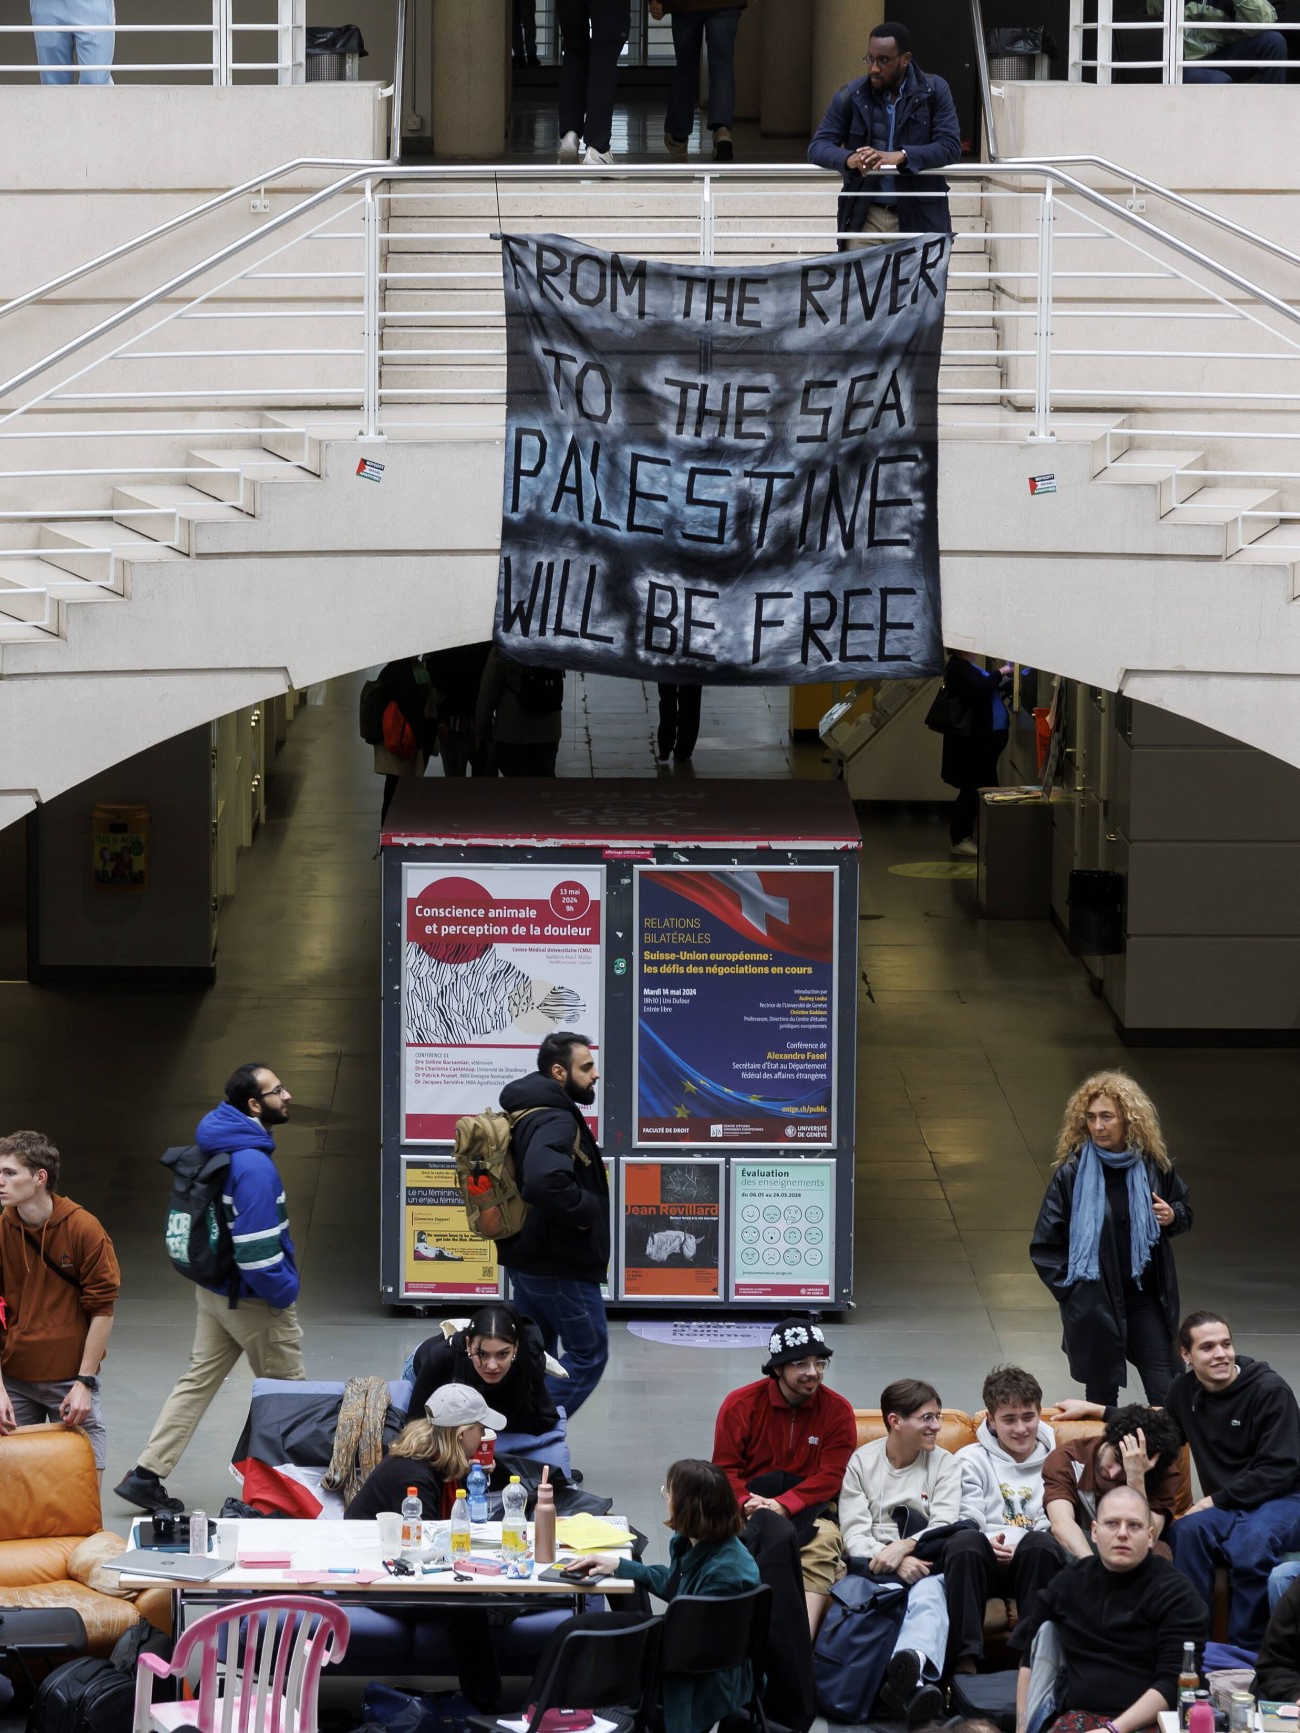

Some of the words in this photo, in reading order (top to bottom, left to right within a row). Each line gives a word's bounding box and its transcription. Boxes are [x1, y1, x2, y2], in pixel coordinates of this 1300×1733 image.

[508, 235, 648, 322] FROM
[676, 275, 770, 330] THE
[798, 235, 948, 330] RIVER
[540, 347, 613, 425] TO
[664, 377, 770, 441] THE
[794, 370, 907, 445] SEA
[512, 426, 918, 550] PALESTINE
[503, 555, 614, 645] WILL
[644, 580, 720, 663] BE
[753, 587, 918, 665] FREE
[415, 906, 484, 918] Conscience
[488, 907, 537, 918] animale
[644, 918, 700, 928] RELATIONS
[425, 924, 438, 935] et
[441, 923, 508, 937] perception
[511, 924, 526, 936] de
[530, 924, 540, 936] la
[544, 925, 591, 936] douleur
[644, 931, 711, 944] BILATÉRALES
[644, 951, 708, 961] Suisse-Union
[644, 964, 658, 974] les
[660, 964, 684, 974] défis
[686, 964, 703, 974] des
[705, 964, 769, 976] négociations
[771, 966, 783, 974] en
[785, 966, 813, 974] cours
[766, 1052, 805, 1060] Alexandre
[806, 1052, 827, 1060] Fasel
[761, 1061, 779, 1069] d'État
[788, 1062, 827, 1071] Département
[741, 1071, 761, 1079] fédéral
[774, 1071, 795, 1079] affaires
[796, 1072, 827, 1081] étrangères
[781, 1105, 827, 1114] unige.ch/public
[642, 1126, 665, 1134] FACULTÉ
[741, 1168, 789, 1178] Évaluation
[741, 1178, 756, 1186] des
[759, 1178, 825, 1188] enseignements
[420, 1197, 439, 1205] enjeu
[625, 1205, 657, 1216] Jean
[660, 1205, 718, 1216] Revillard
